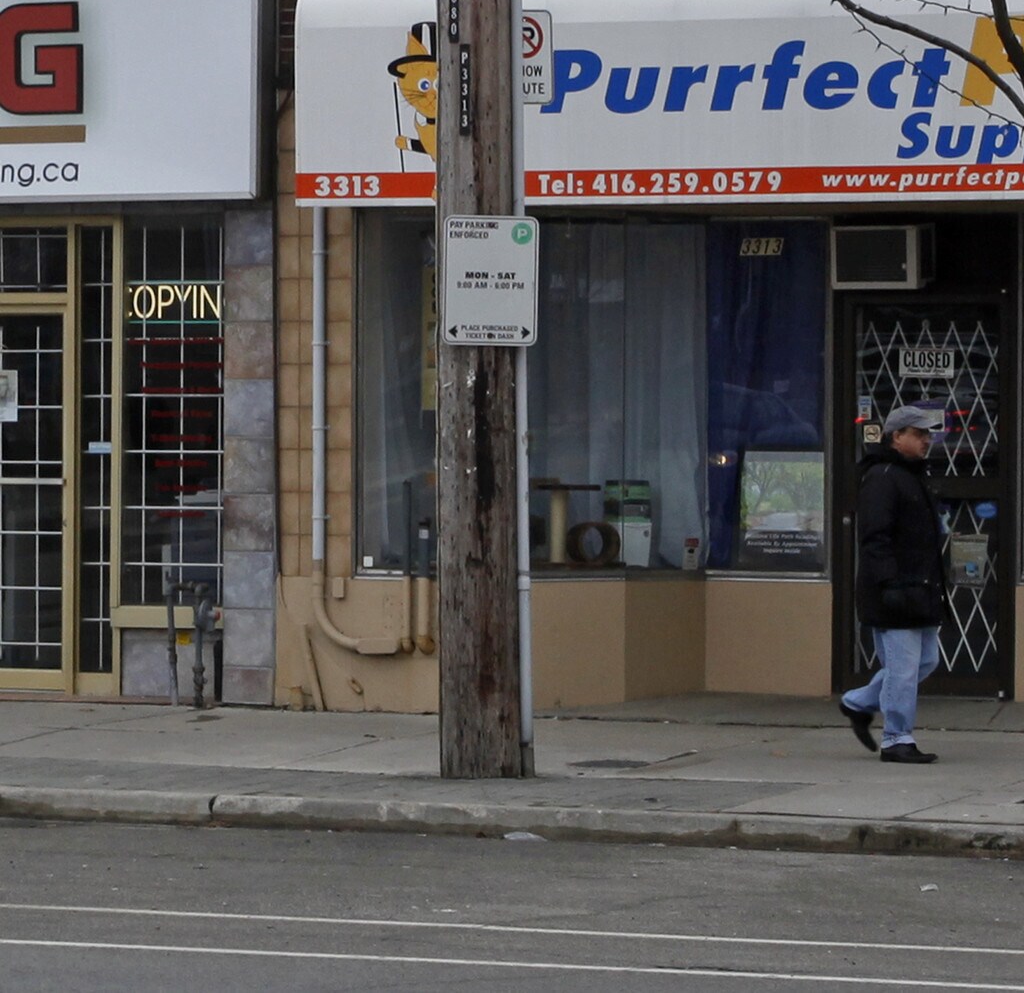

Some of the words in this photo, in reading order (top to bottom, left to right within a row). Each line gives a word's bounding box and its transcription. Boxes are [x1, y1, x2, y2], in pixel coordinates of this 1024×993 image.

[0, 1, 84, 116] G
[522, 65, 543, 77] OW
[539, 40, 951, 114] Purrfect
[460, 52, 470, 128] P3313
[522, 83, 546, 95] UTE
[1, 163, 79, 187] ng.ca
[539, 174, 584, 194] Tel:
[592, 171, 782, 194] 416.259.0579
[314, 176, 380, 197] 3313
[450, 231, 489, 239] ENFORCED
[741, 238, 782, 255] 3313
[497, 272, 516, 280] SAT
[128, 285, 220, 319] OPYIN
[903, 351, 951, 368] CLOSED
